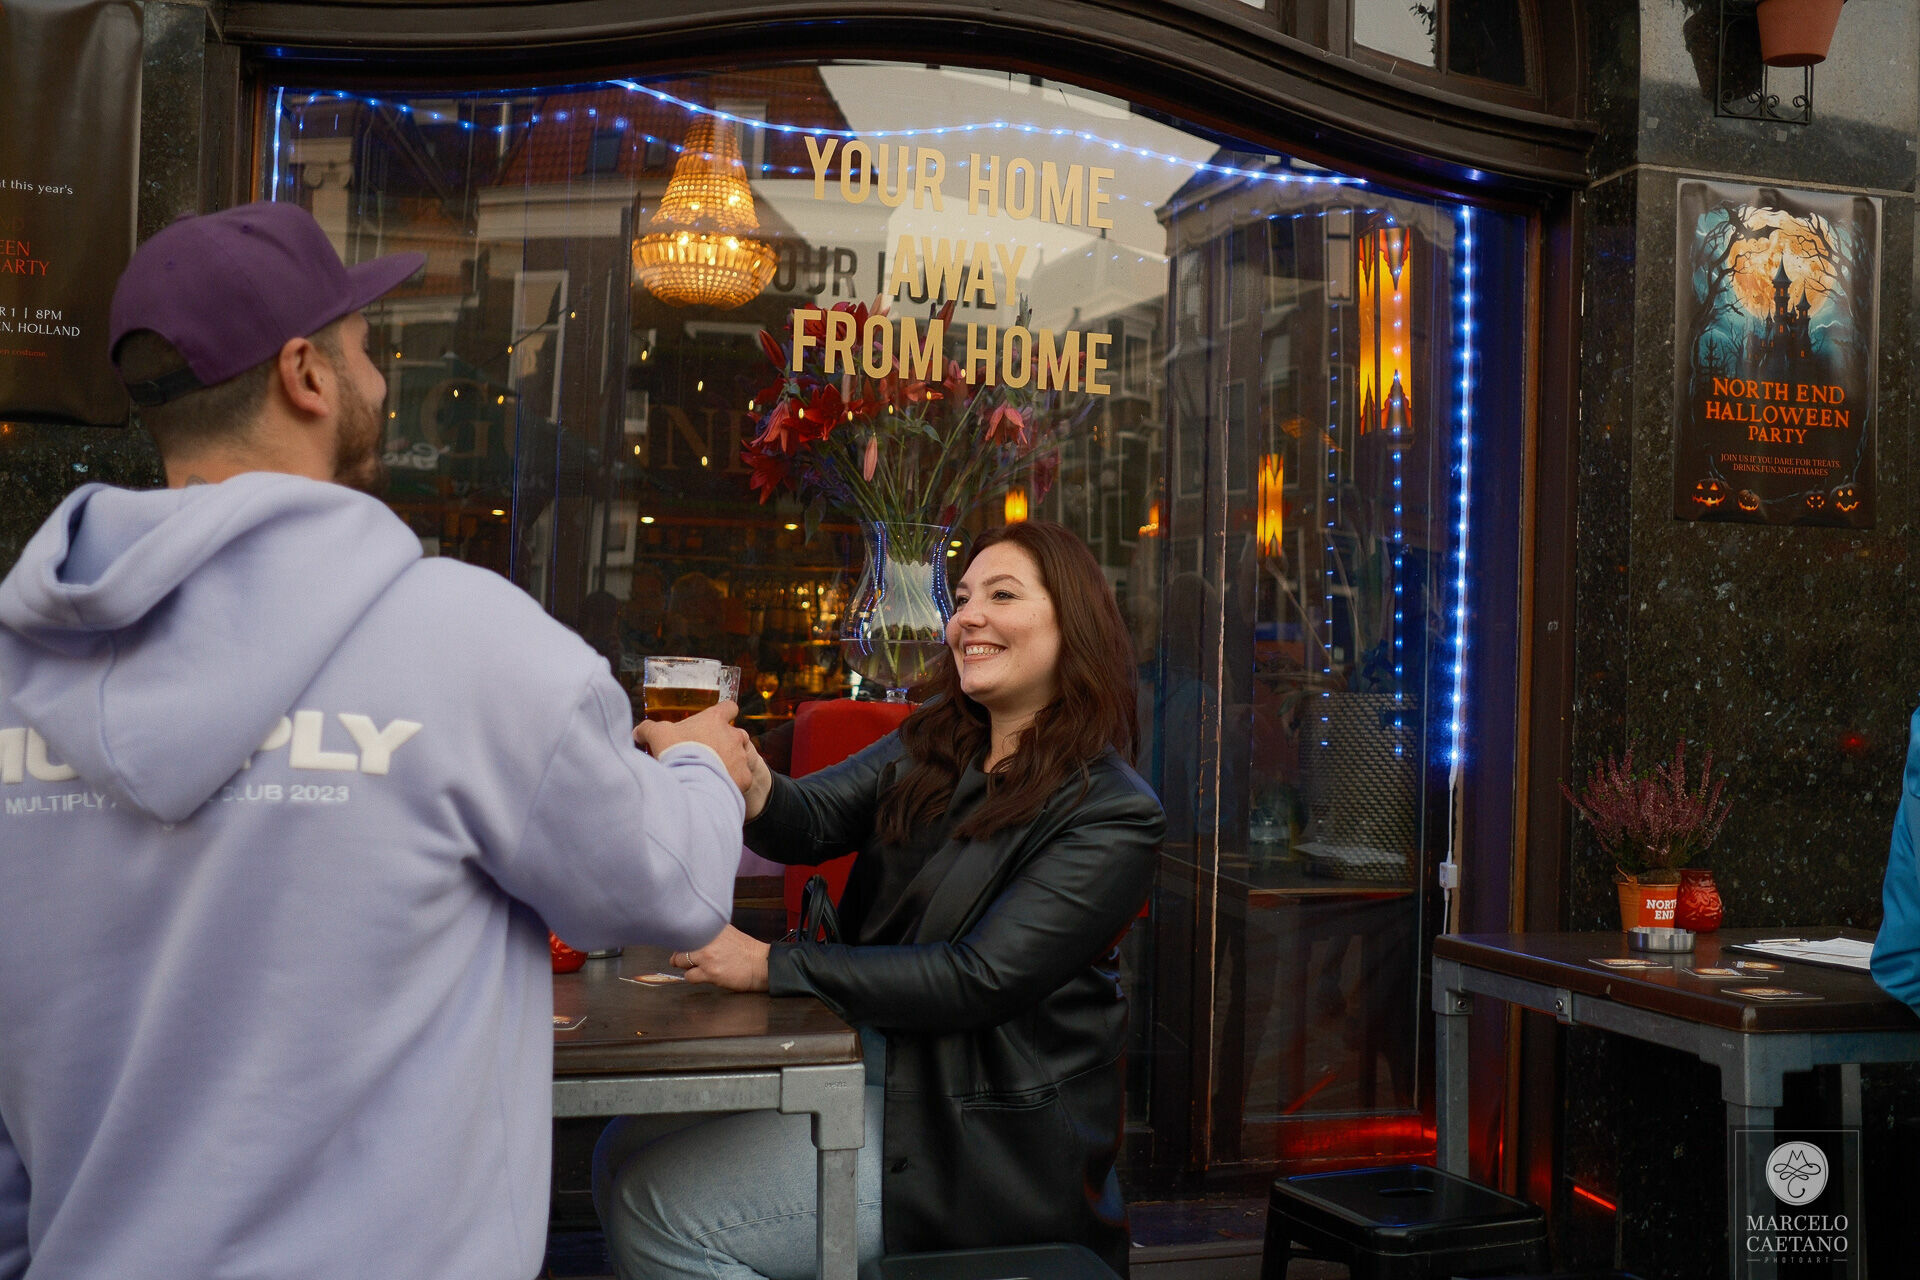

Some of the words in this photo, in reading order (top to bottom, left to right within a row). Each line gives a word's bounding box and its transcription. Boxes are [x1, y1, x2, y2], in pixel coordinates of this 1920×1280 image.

[11, 179, 33, 191] this
[38, 184, 73, 195] year's
[804, 136, 946, 212] YOUR
[968, 153, 1115, 229] HOME
[888, 234, 1027, 306] AWAY
[35, 309, 62, 320] 8PM
[18, 322, 80, 337] HOLLAND
[792, 308, 944, 382] FROM
[965, 322, 1113, 395] HOME
[1712, 377, 1789, 401] NORTH
[1796, 384, 1845, 404] END
[1705, 401, 1850, 429] HALLOWEEN
[1748, 425, 1808, 444] PARTY
[1720, 453, 1738, 462] JOIN
[1738, 454, 1749, 463] US
[1757, 456, 1773, 465] YOU
[1774, 457, 1794, 466] DARE
[1795, 458, 1811, 467] FOR
[5, 791, 106, 815] MULTIPLY
[290, 784, 350, 802] 2023
[1654, 910, 1675, 920] END
